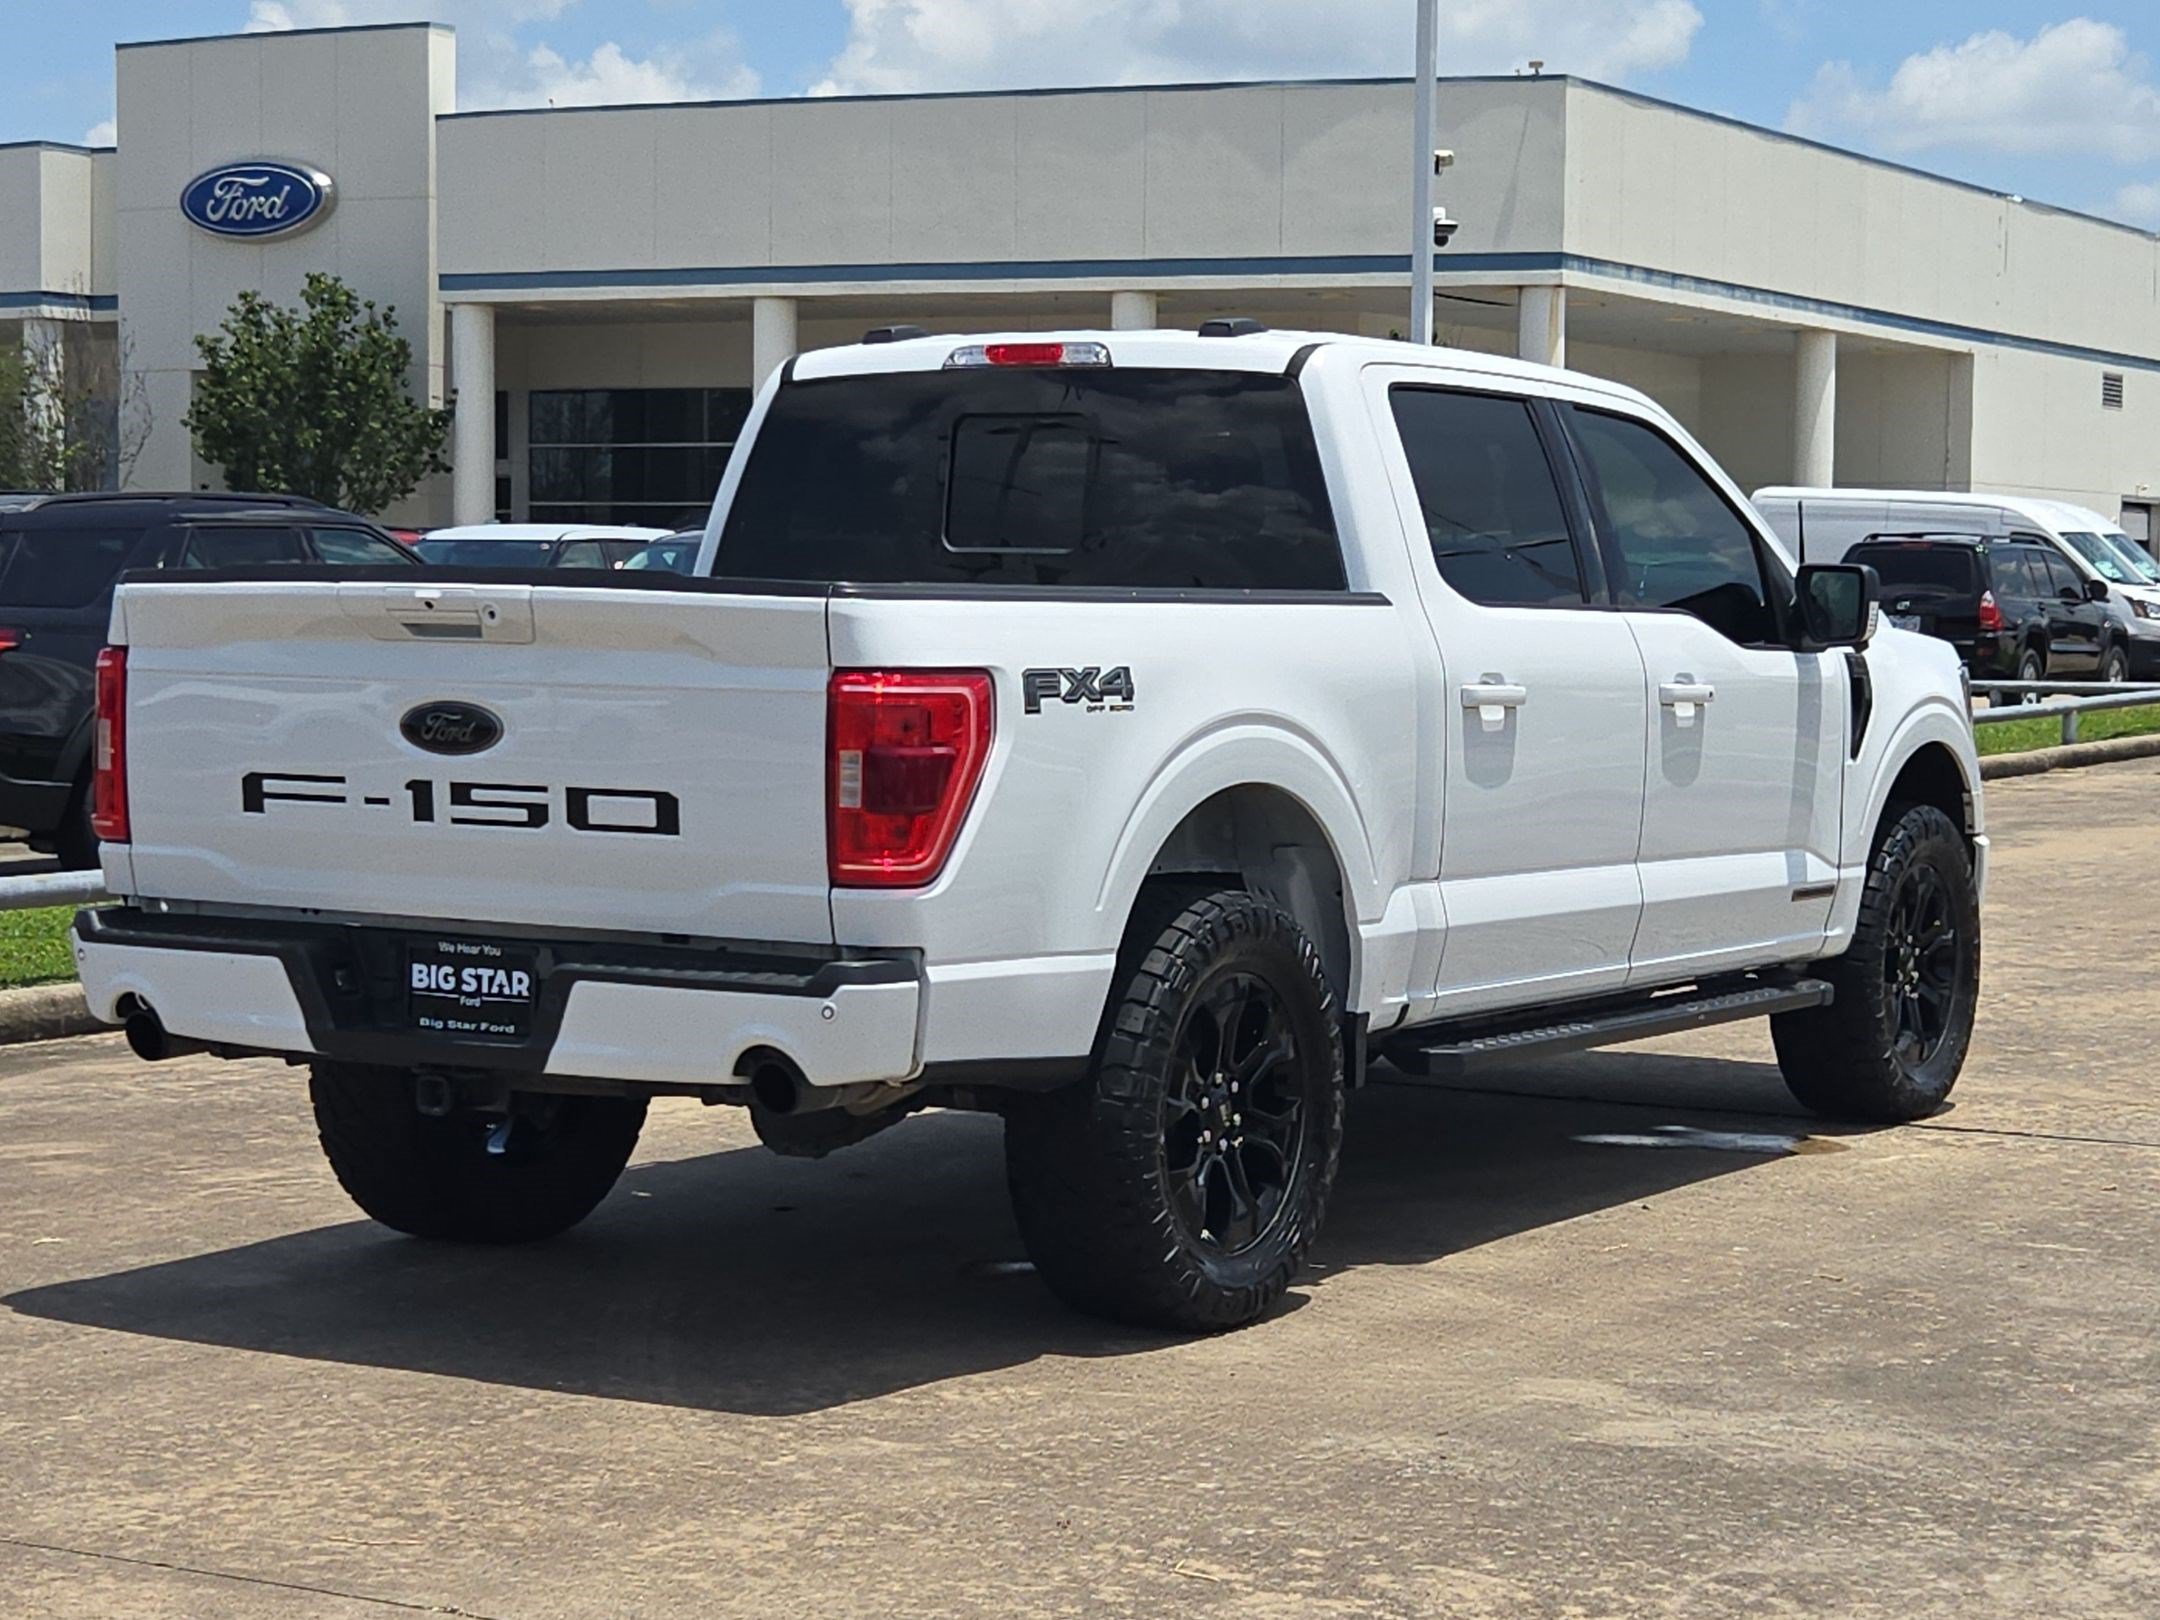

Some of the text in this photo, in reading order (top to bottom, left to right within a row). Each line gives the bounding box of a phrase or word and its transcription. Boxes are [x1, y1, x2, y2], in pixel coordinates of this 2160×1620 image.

[206, 176, 290, 222] Ford
[1022, 666, 1134, 714] FX4
[421, 712, 476, 741] Ford
[242, 772, 680, 835] F-150
[438, 941, 501, 956] We Hear You
[412, 963, 530, 996] BIG STAR
[460, 996, 481, 1007] Ford
[419, 1017, 515, 1033] Big Star Ford
